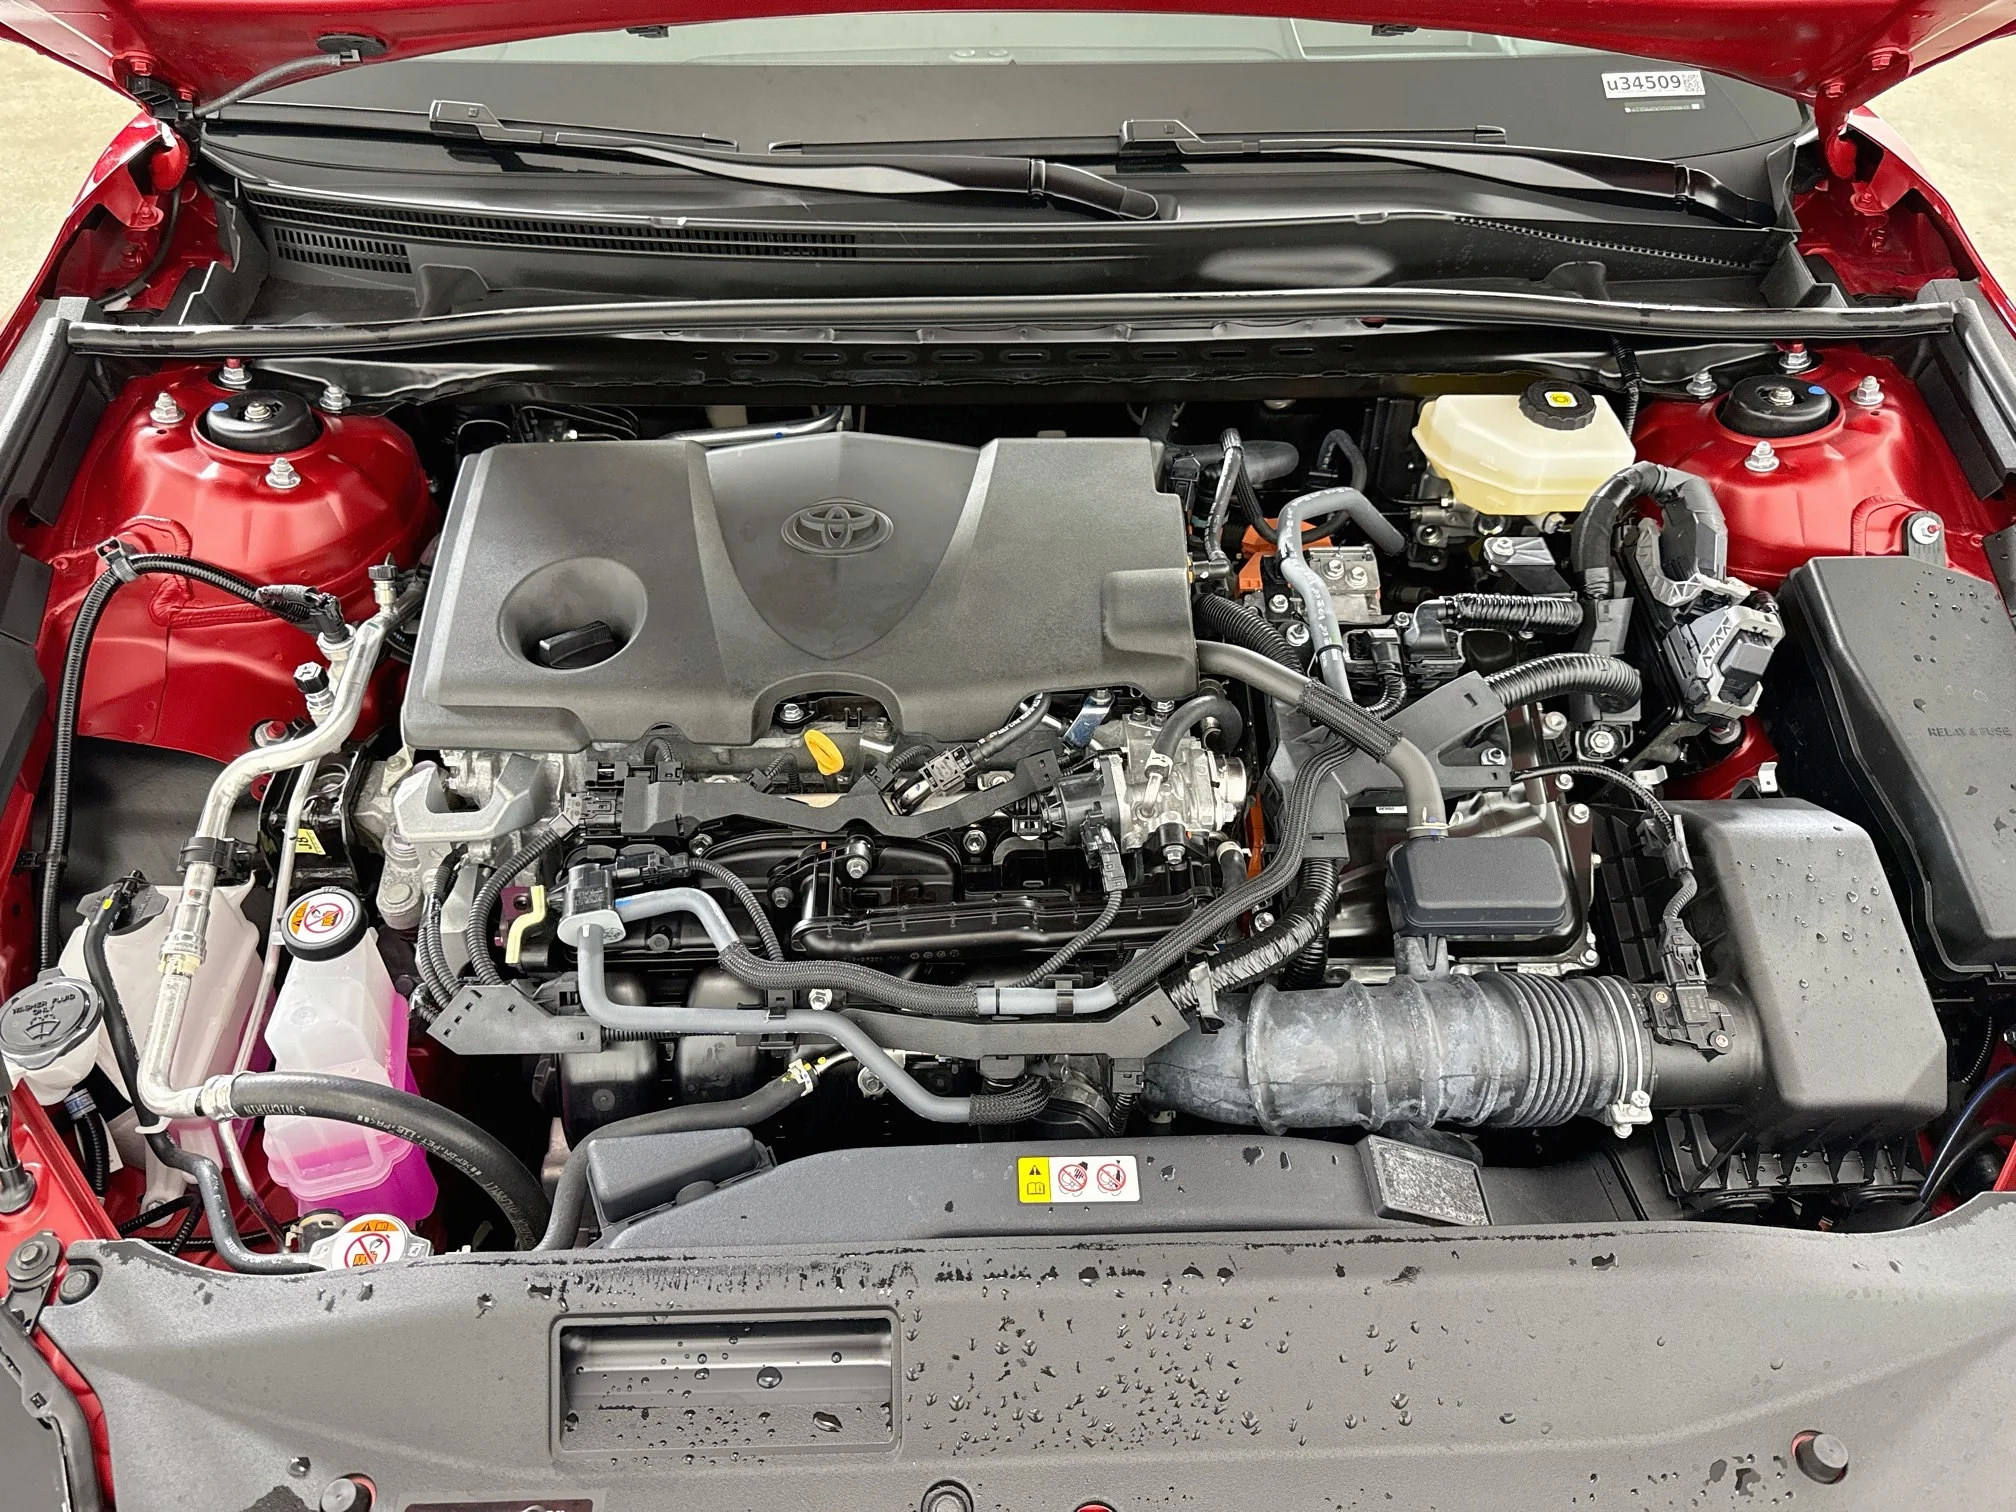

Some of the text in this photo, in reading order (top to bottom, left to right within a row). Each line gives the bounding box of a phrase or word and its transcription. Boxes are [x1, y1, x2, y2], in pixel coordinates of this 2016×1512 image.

[1606, 75, 1681, 91] u34509
[1927, 726, 1967, 737] RELAY
[1979, 726, 2012, 737] FUSE
[12, 993, 76, 1014] WASHER FLUID
